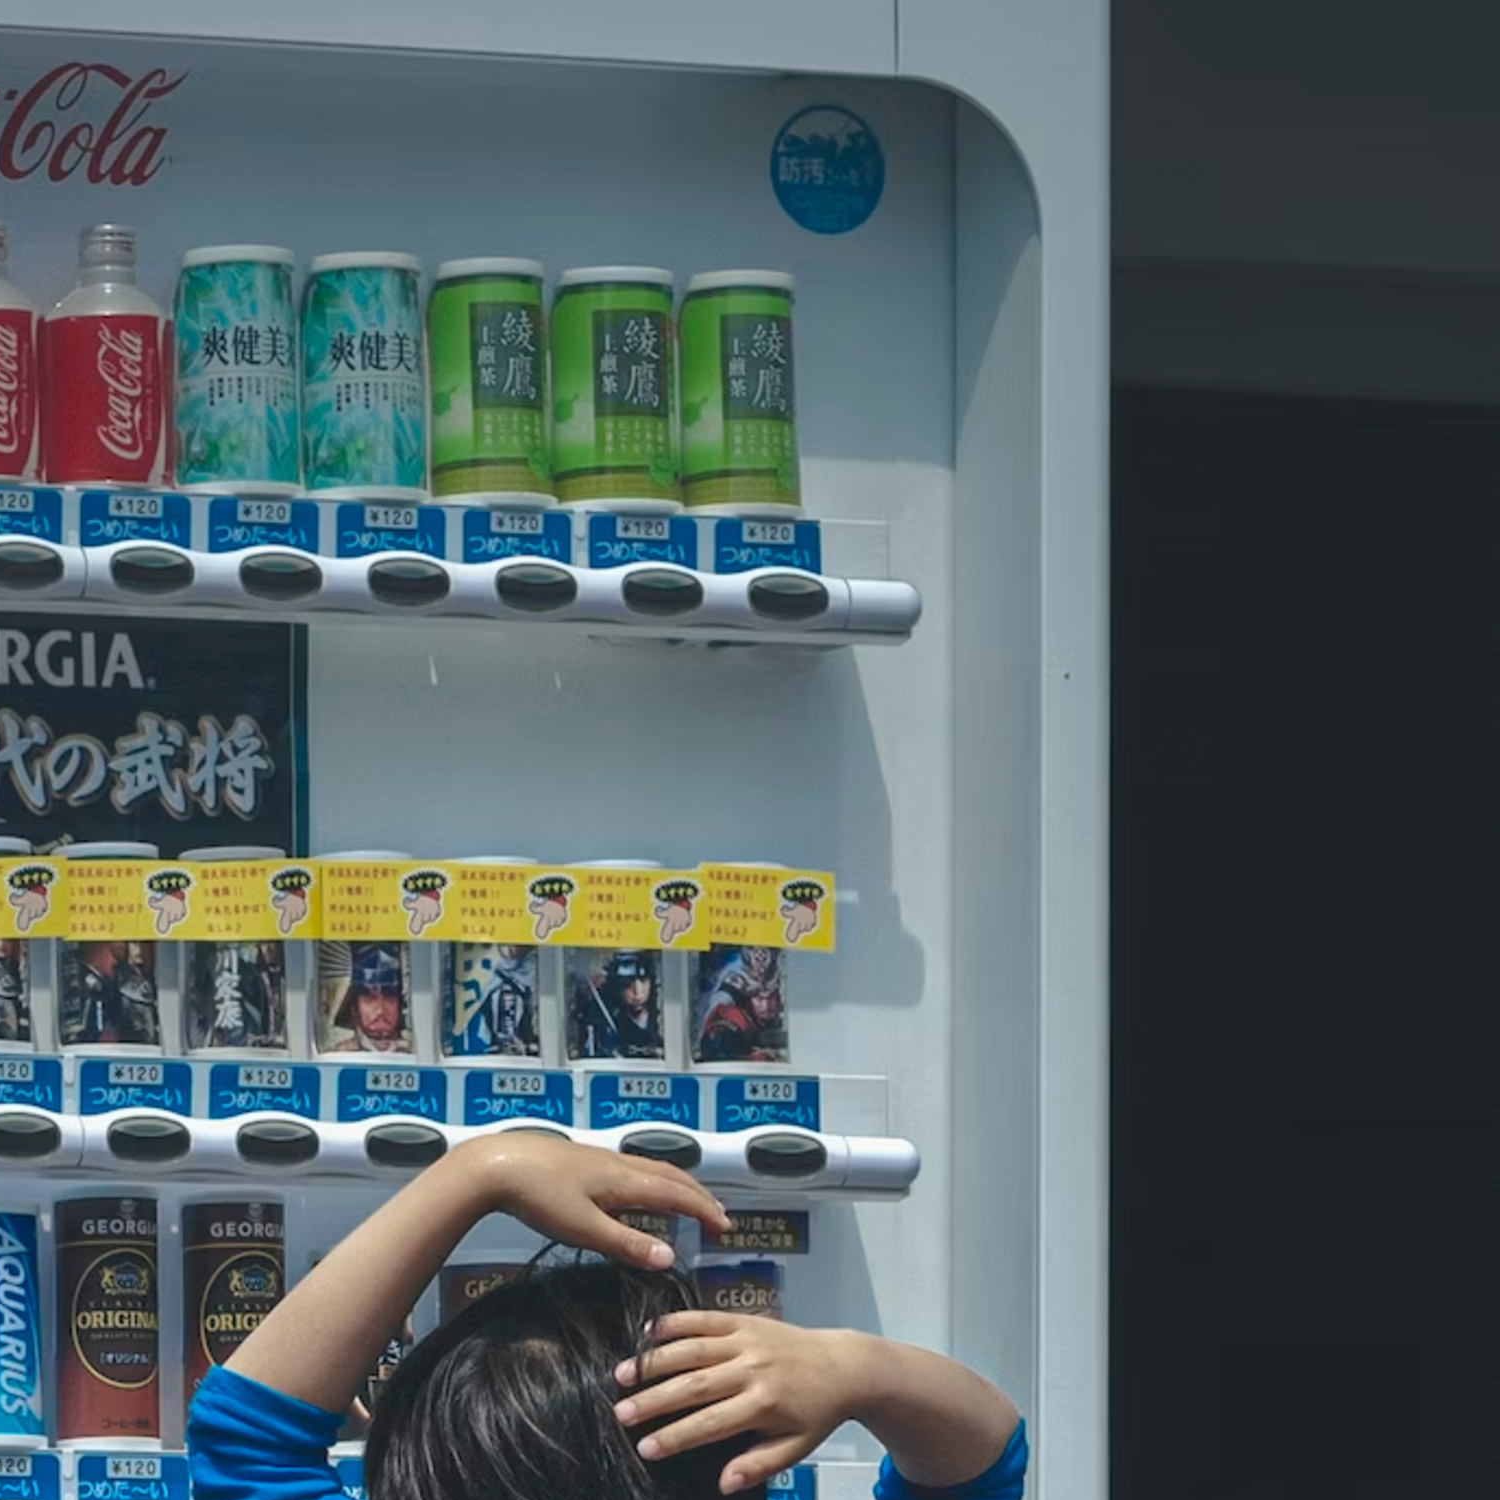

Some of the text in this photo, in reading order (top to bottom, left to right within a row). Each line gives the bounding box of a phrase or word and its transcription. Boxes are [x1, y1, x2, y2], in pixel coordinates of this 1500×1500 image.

[201, 325, 294, 368] 爽健美
[329, 330, 419, 374] 爽健美
[500, 309, 536, 401] 綾鷹
[623, 316, 660, 408] 綾鷹
[750, 321, 787, 413] 綾鷹
[114, 495, 159, 514] ¥120
[242, 501, 287, 520] ¥120
[370, 507, 414, 526] ¥120
[497, 512, 540, 531] ¥120
[622, 518, 666, 537] ¥120
[747, 524, 790, 543] ¥120
[115, 1065, 160, 1081] ¥120
[243, 1068, 288, 1085] ¥120
[371, 1072, 415, 1089] ¥120
[498, 1076, 542, 1092] ¥120
[624, 1079, 667, 1096] ¥120
[749, 1083, 792, 1100] ¥120
[112, 1459, 157, 1475] ¥120
